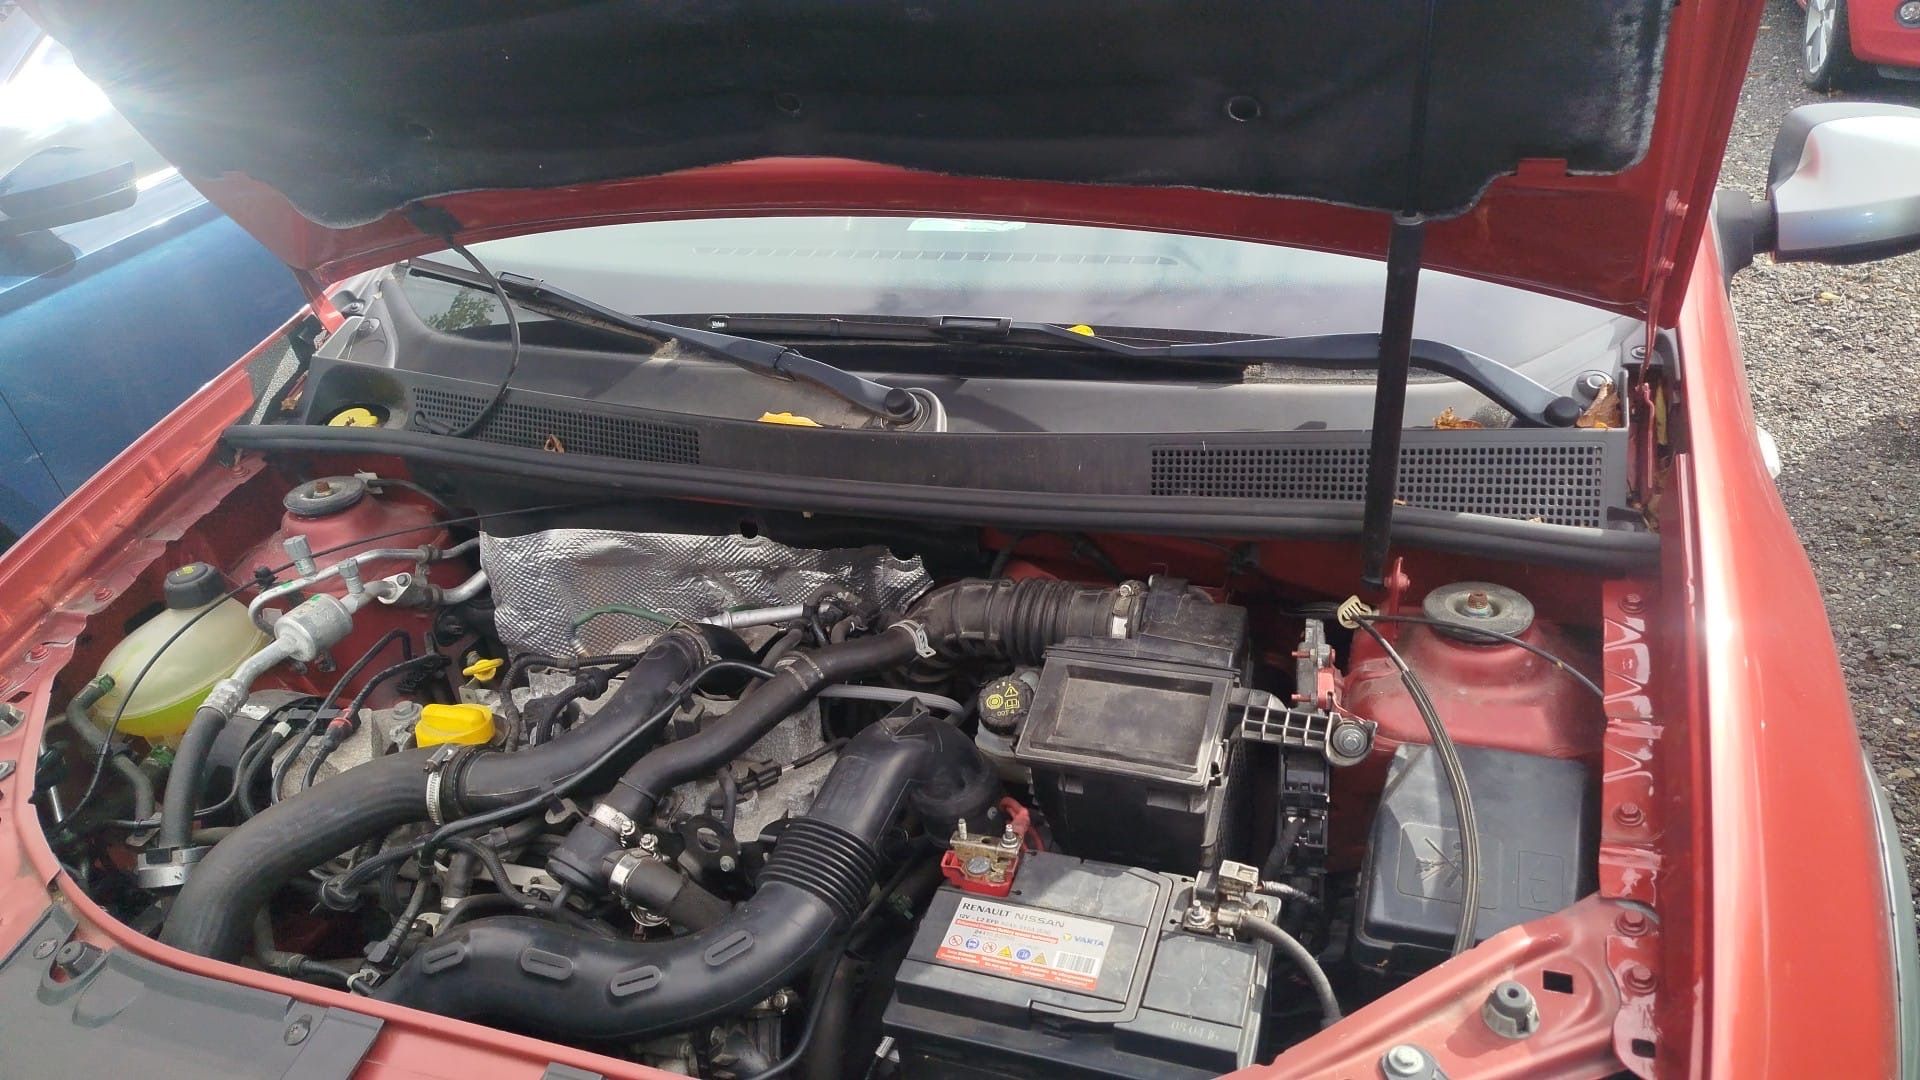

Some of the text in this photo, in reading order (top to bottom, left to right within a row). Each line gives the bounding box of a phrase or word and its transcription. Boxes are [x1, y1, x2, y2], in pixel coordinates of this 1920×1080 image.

[962, 902, 1010, 917] RENAULT
[1014, 912, 1065, 928] NISSAN
[1074, 935, 1105, 947] VARTA
